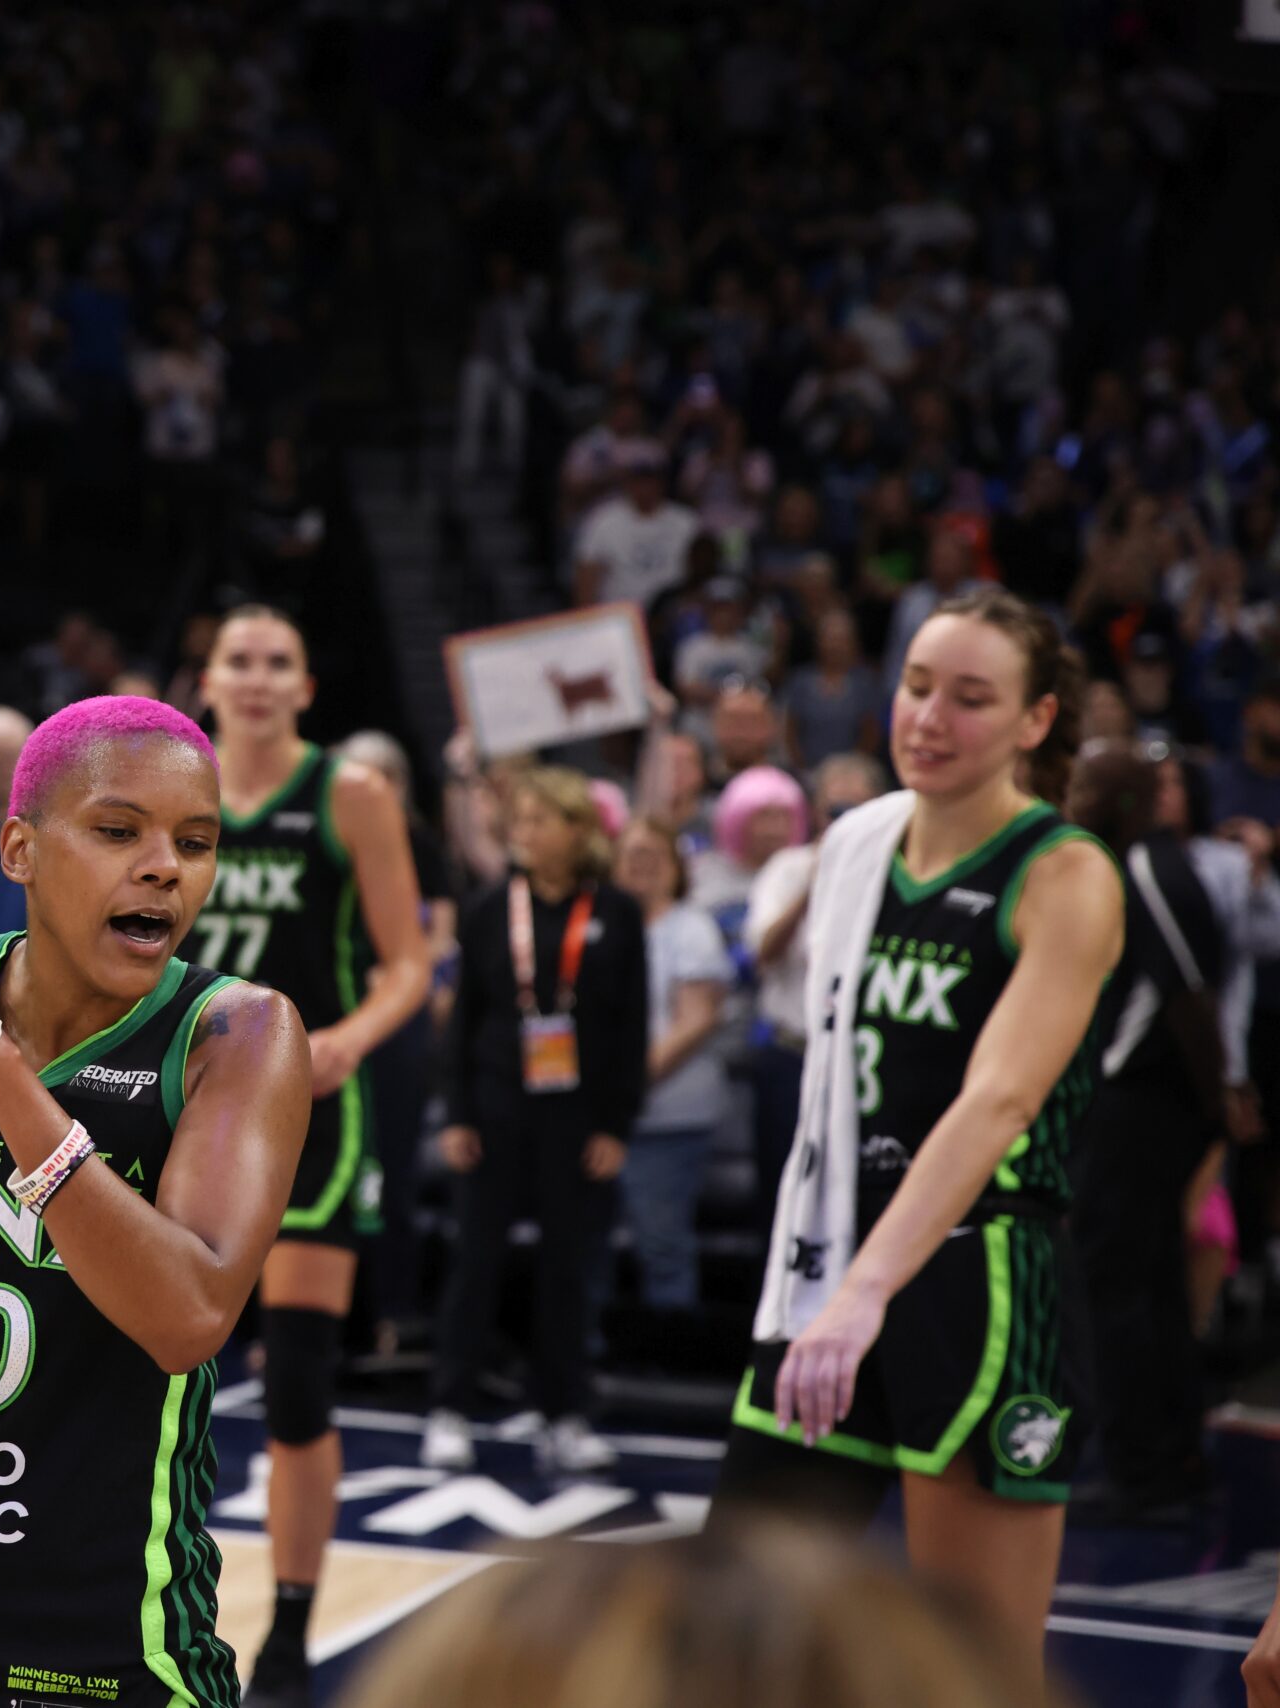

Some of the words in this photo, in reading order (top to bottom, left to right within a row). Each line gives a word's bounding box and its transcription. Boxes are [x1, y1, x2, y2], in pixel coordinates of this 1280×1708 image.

[194, 914, 271, 979] 77
[75, 1065, 158, 1085] FEDERATED
[42, 1163, 55, 1176] DO
[7, 1677, 33, 1690] NIKE
[35, 1681, 69, 1693] REBEL
[71, 1687, 118, 1701] EDITION
[9, 1665, 82, 1686] MINNESOTA
[86, 1676, 119, 1689] LYNX
